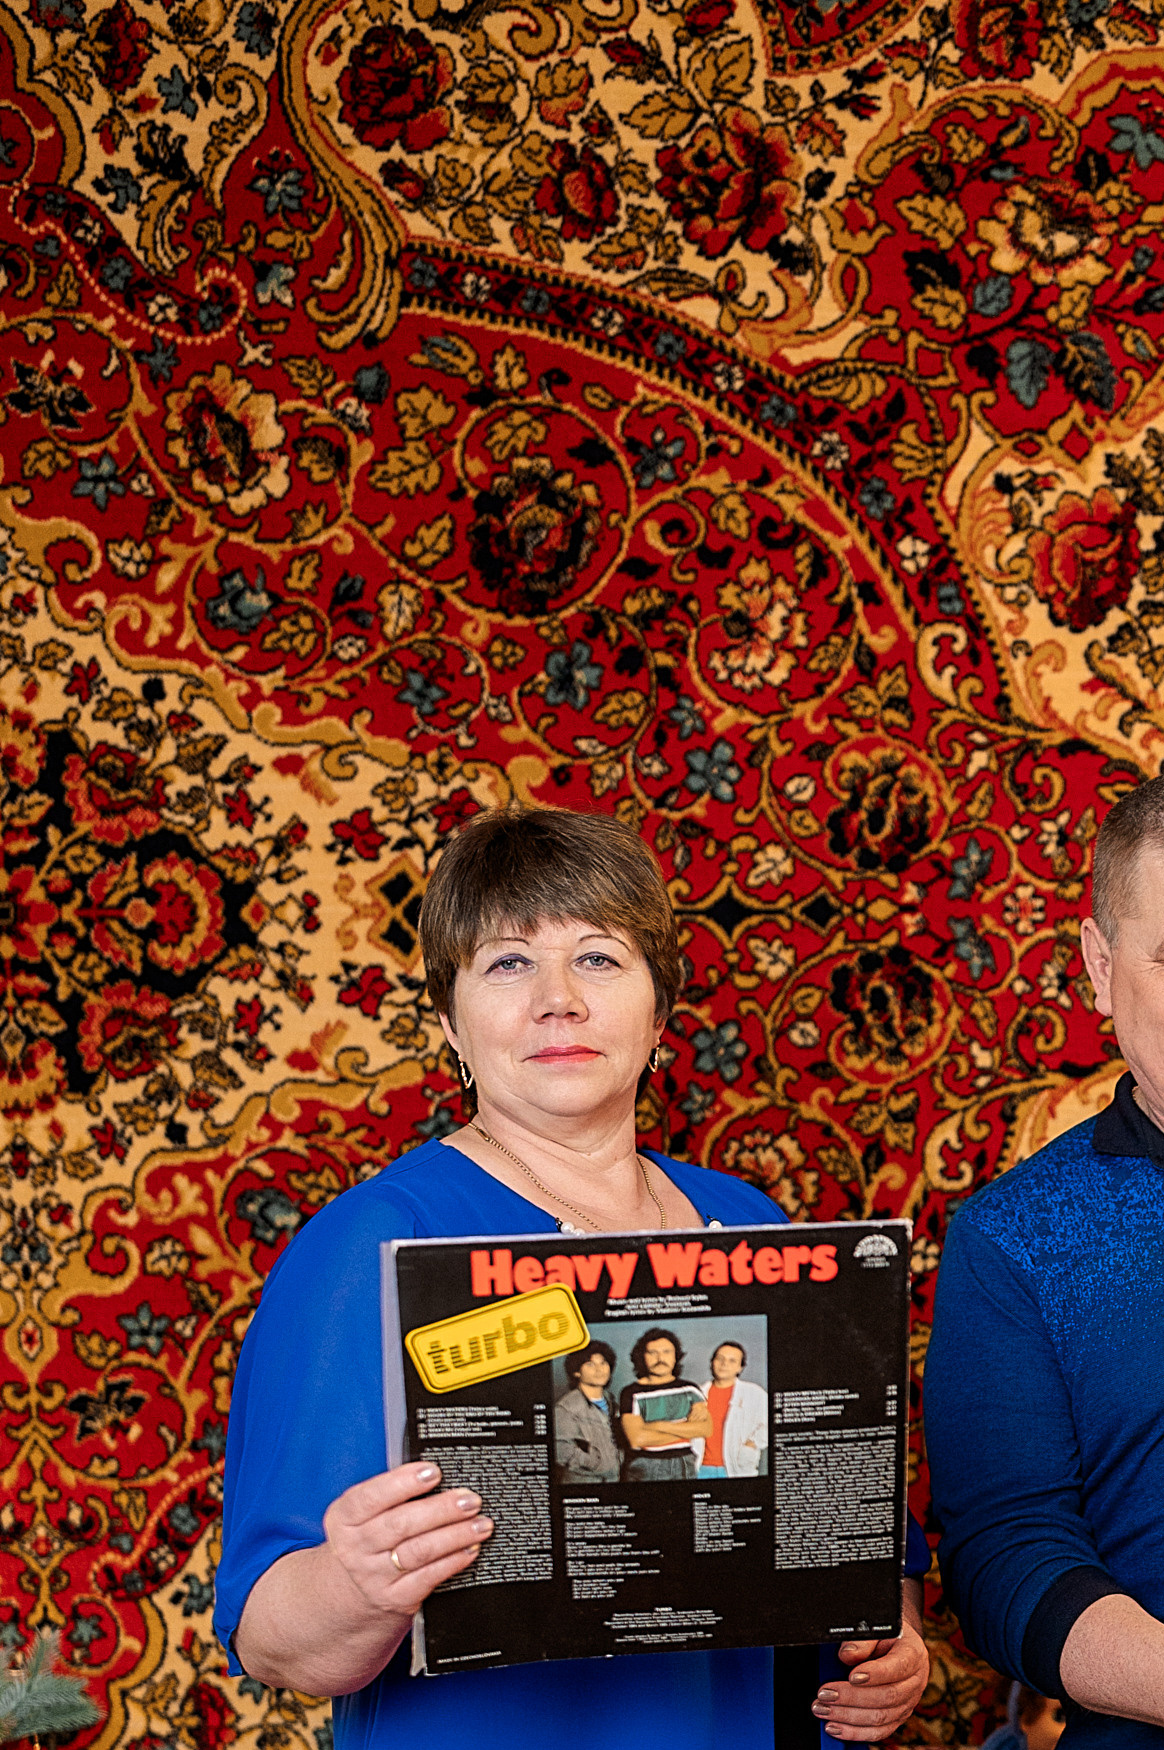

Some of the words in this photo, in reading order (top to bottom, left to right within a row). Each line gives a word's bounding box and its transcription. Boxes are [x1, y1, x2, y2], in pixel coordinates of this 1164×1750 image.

[470, 1249, 638, 1299] Heavy
[646, 1240, 839, 1289] Waters
[427, 1310, 570, 1376] turbo
